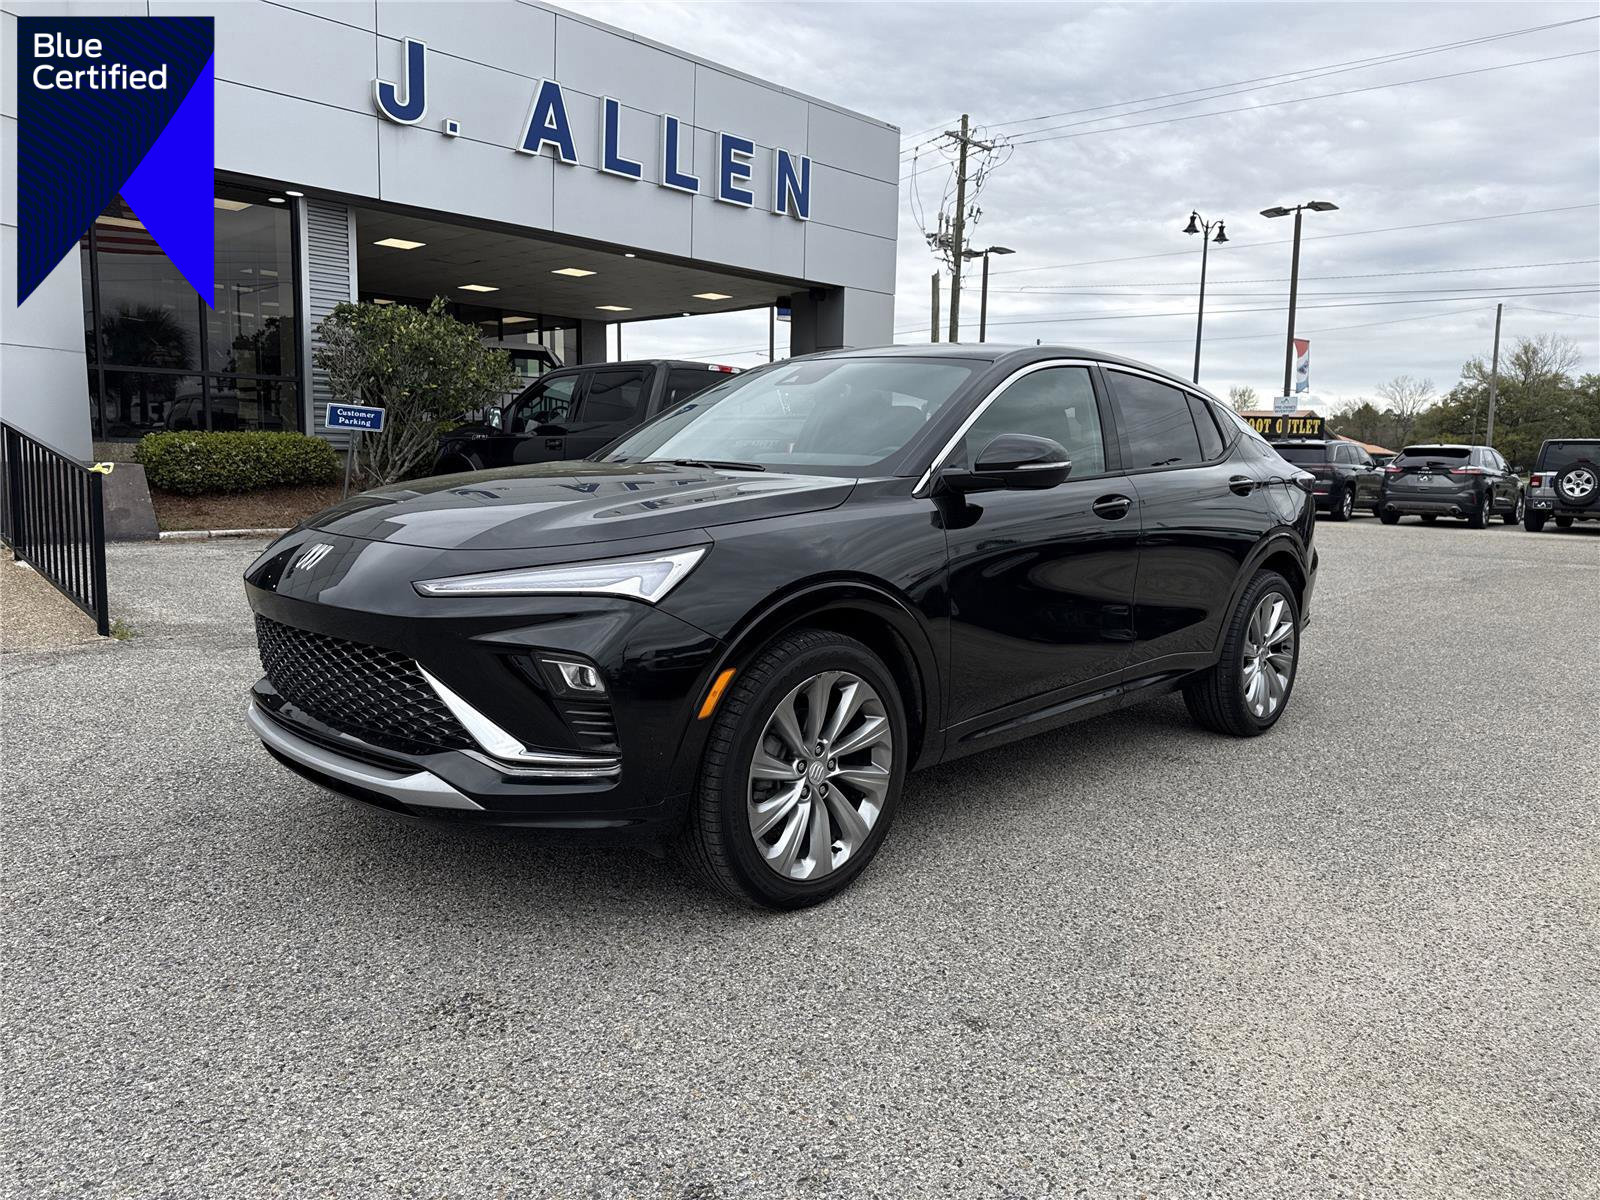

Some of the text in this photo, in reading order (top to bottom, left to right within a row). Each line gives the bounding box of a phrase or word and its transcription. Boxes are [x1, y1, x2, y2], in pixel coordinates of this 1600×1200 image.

[372, 37, 812, 221] J. ALLEN
[337, 408, 375, 419] Customer
[338, 416, 371, 427] Parking
[1248, 418, 1272, 433] OOT
